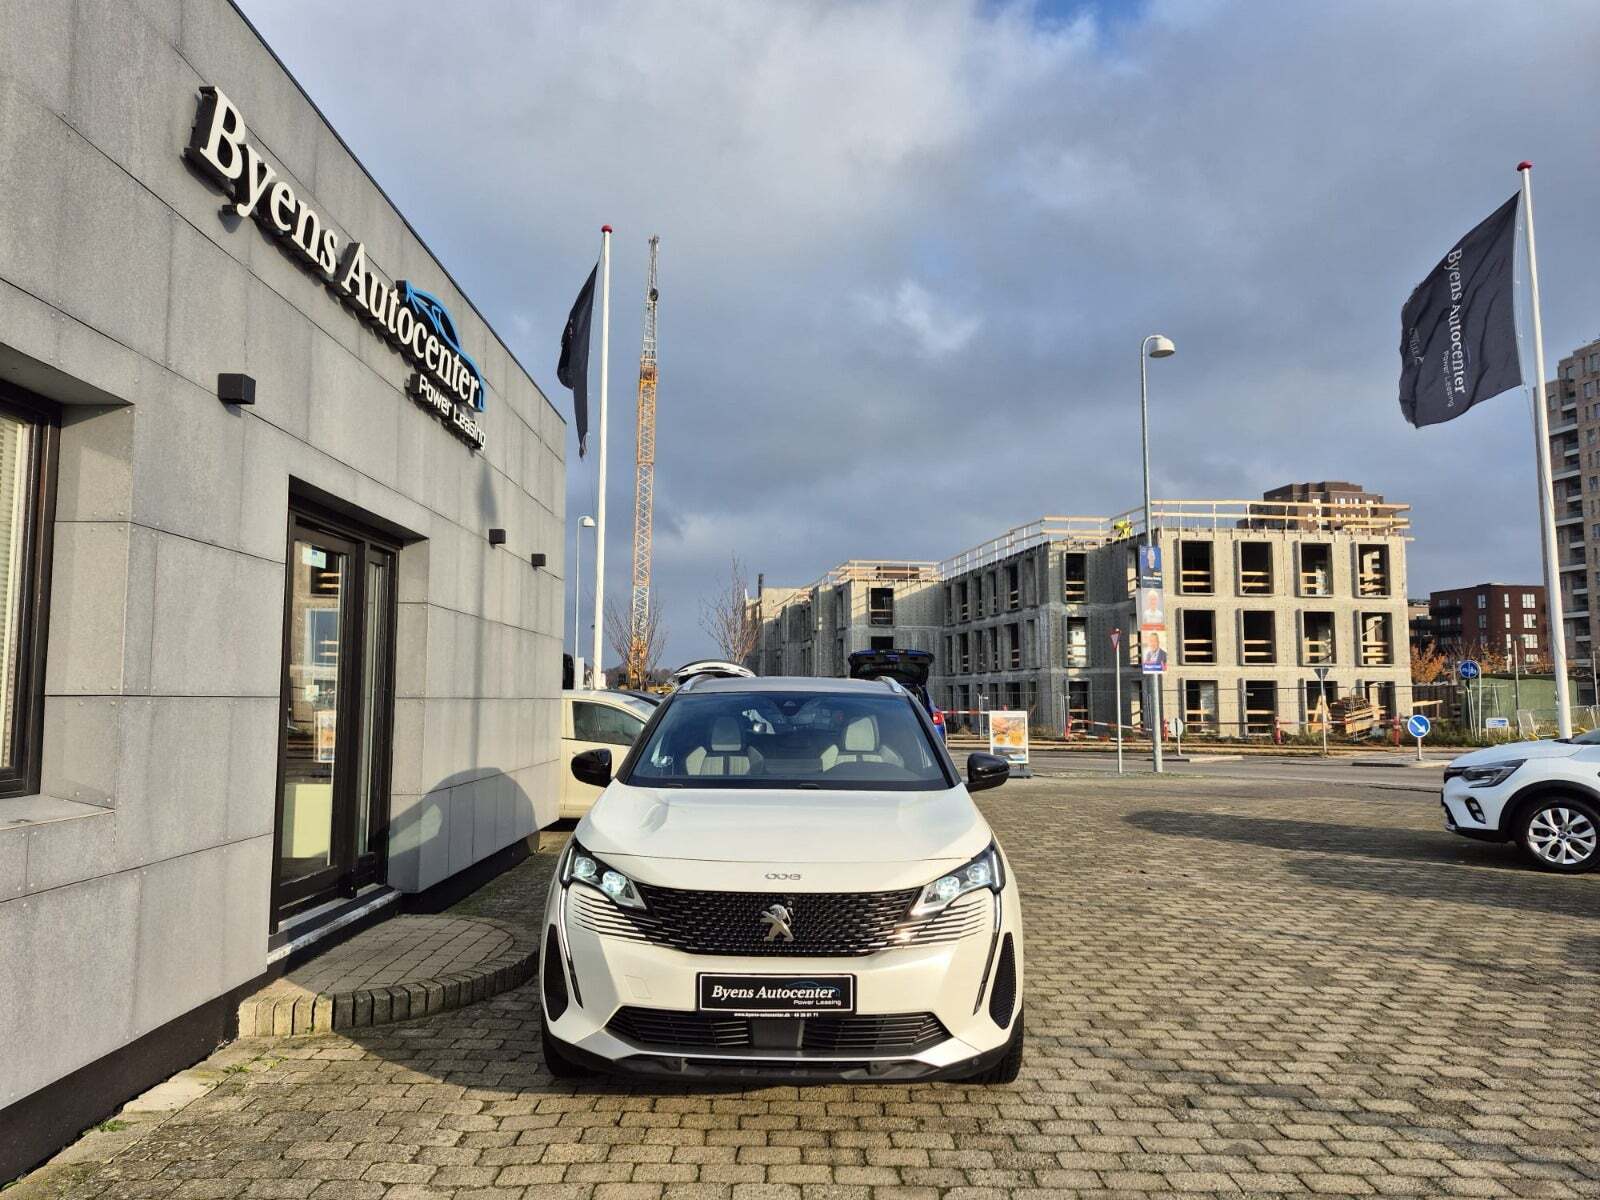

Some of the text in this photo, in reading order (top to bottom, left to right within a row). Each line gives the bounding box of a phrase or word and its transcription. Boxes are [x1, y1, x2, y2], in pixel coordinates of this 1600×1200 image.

[199, 85, 480, 407] Byens Autocenter
[1445, 247, 1466, 394] Byens Autocenter
[418, 374, 486, 451] Power Leasing
[711, 984, 835, 1001] Byens Autocenter
